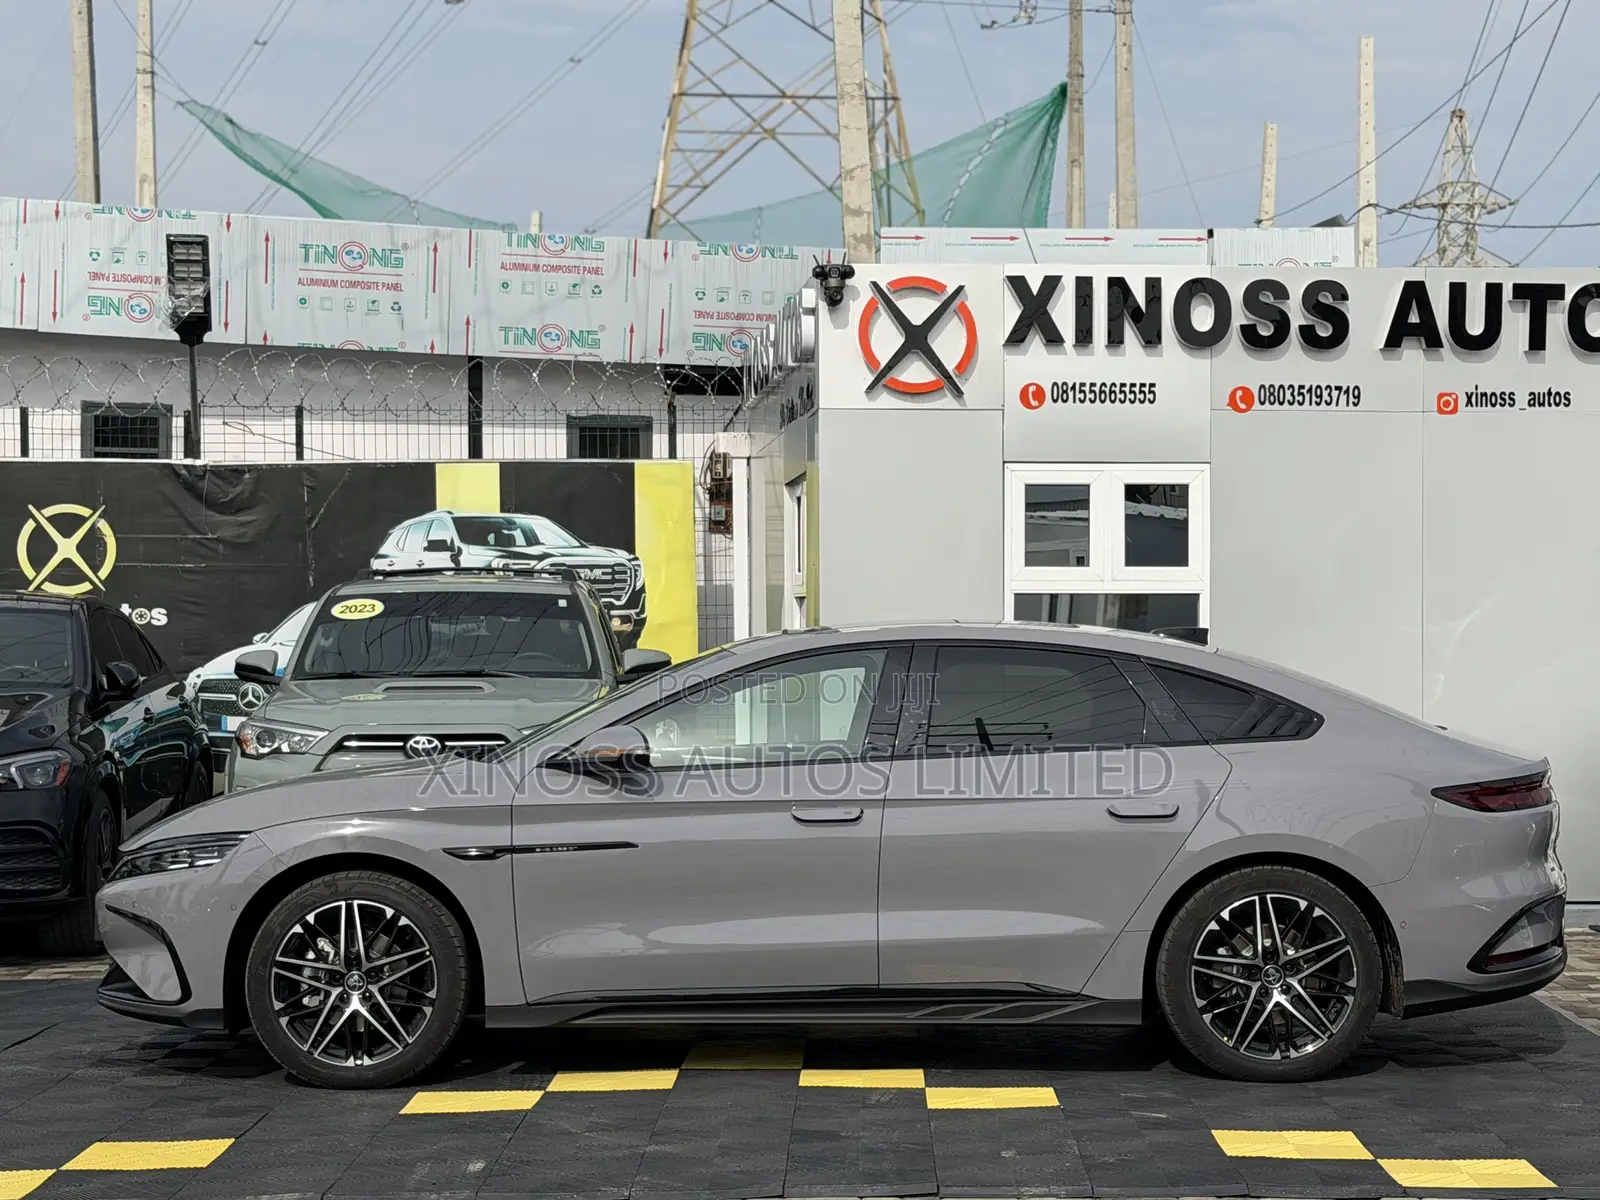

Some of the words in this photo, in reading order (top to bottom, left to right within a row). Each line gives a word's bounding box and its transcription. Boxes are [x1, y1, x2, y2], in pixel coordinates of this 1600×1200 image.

[500, 262, 540, 272] ALUMINIUM
[541, 264, 581, 275] COMPOSITE
[582, 266, 604, 276] PANEL
[87, 271, 110, 282] PANEL
[111, 273, 153, 285] COMPOSITE
[297, 277, 339, 289] ALUMINIUM
[339, 280, 380, 291] COMPOSITE
[381, 281, 404, 292] PANEL
[693, 310, 715, 320] PANEL
[1003, 275, 1350, 350] XINOSS
[1050, 381, 1157, 405] 08155665555
[1258, 384, 1362, 407] 08035193719
[1464, 384, 1572, 411] xinoss_autos
[339, 603, 376, 615] 2023
